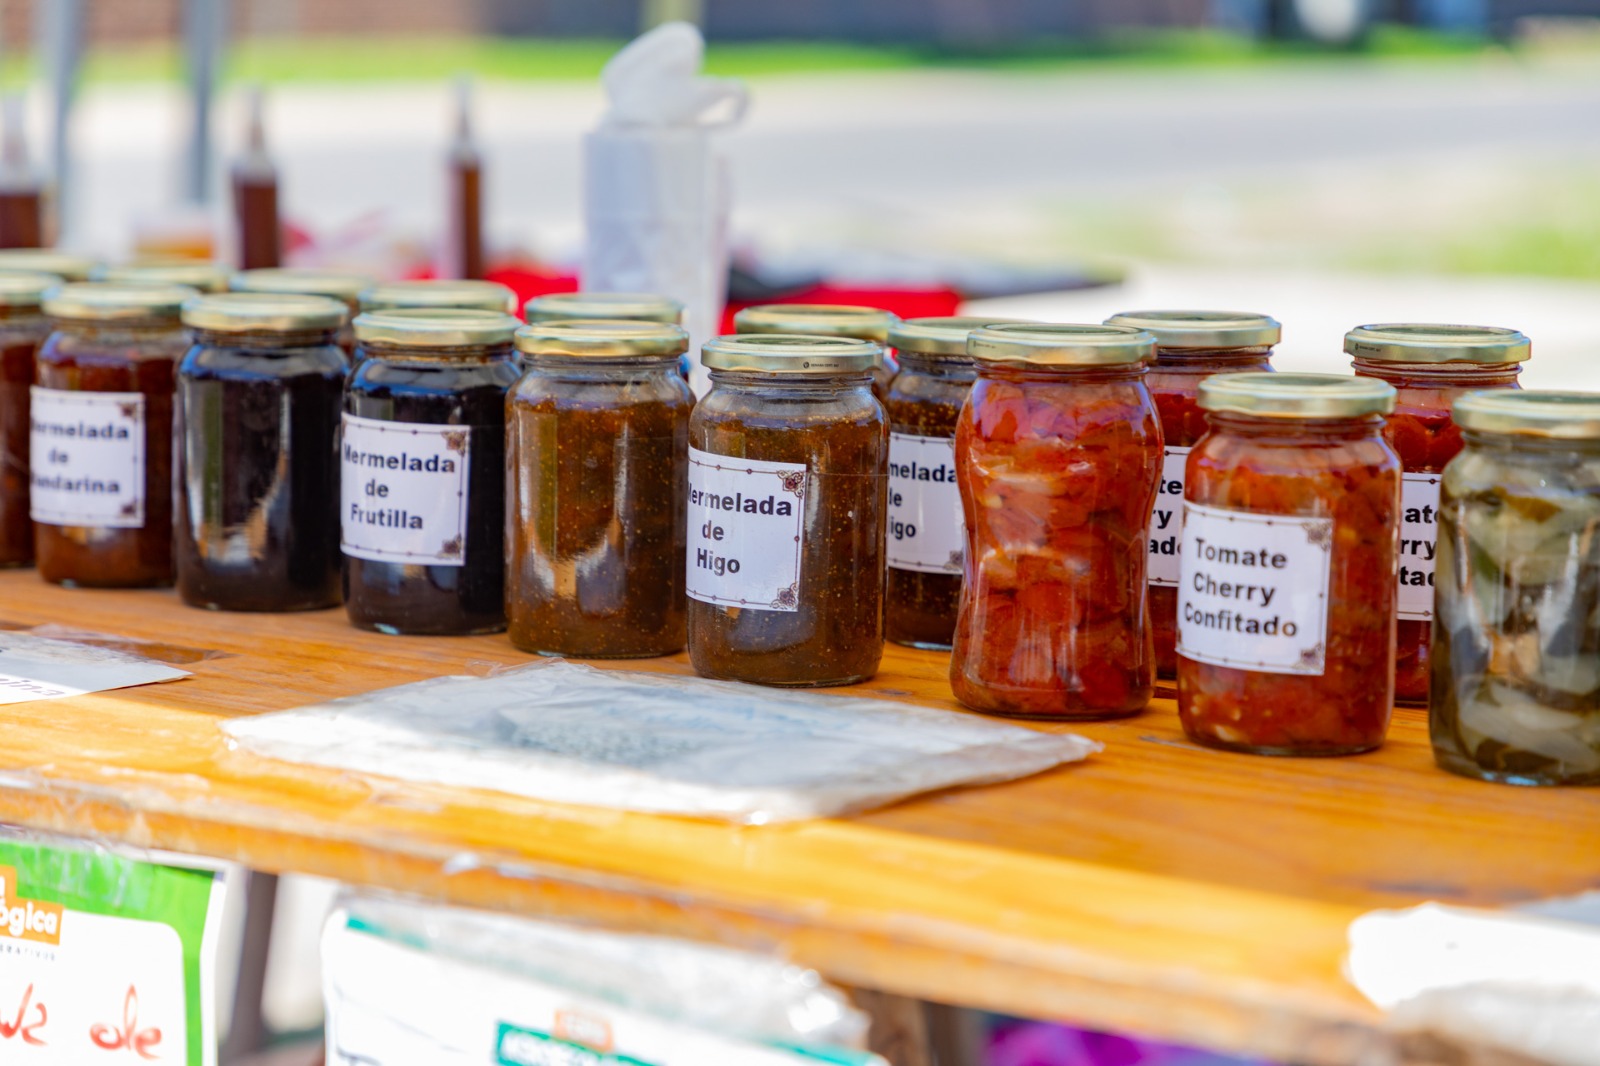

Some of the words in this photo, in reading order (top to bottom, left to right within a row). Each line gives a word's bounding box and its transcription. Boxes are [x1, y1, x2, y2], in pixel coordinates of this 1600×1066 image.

[31, 418, 130, 440] ermelada
[49, 447, 69, 464] de
[31, 471, 120, 494] andarina
[365, 478, 389, 498] de
[350, 503, 423, 530] Frutilla
[1152, 509, 1173, 529] y
[702, 520, 724, 541] de
[696, 547, 740, 577] Higo
[1195, 537, 1288, 569] Tomate
[1193, 571, 1276, 606] Cherry
[1184, 602, 1297, 637] Confitado
